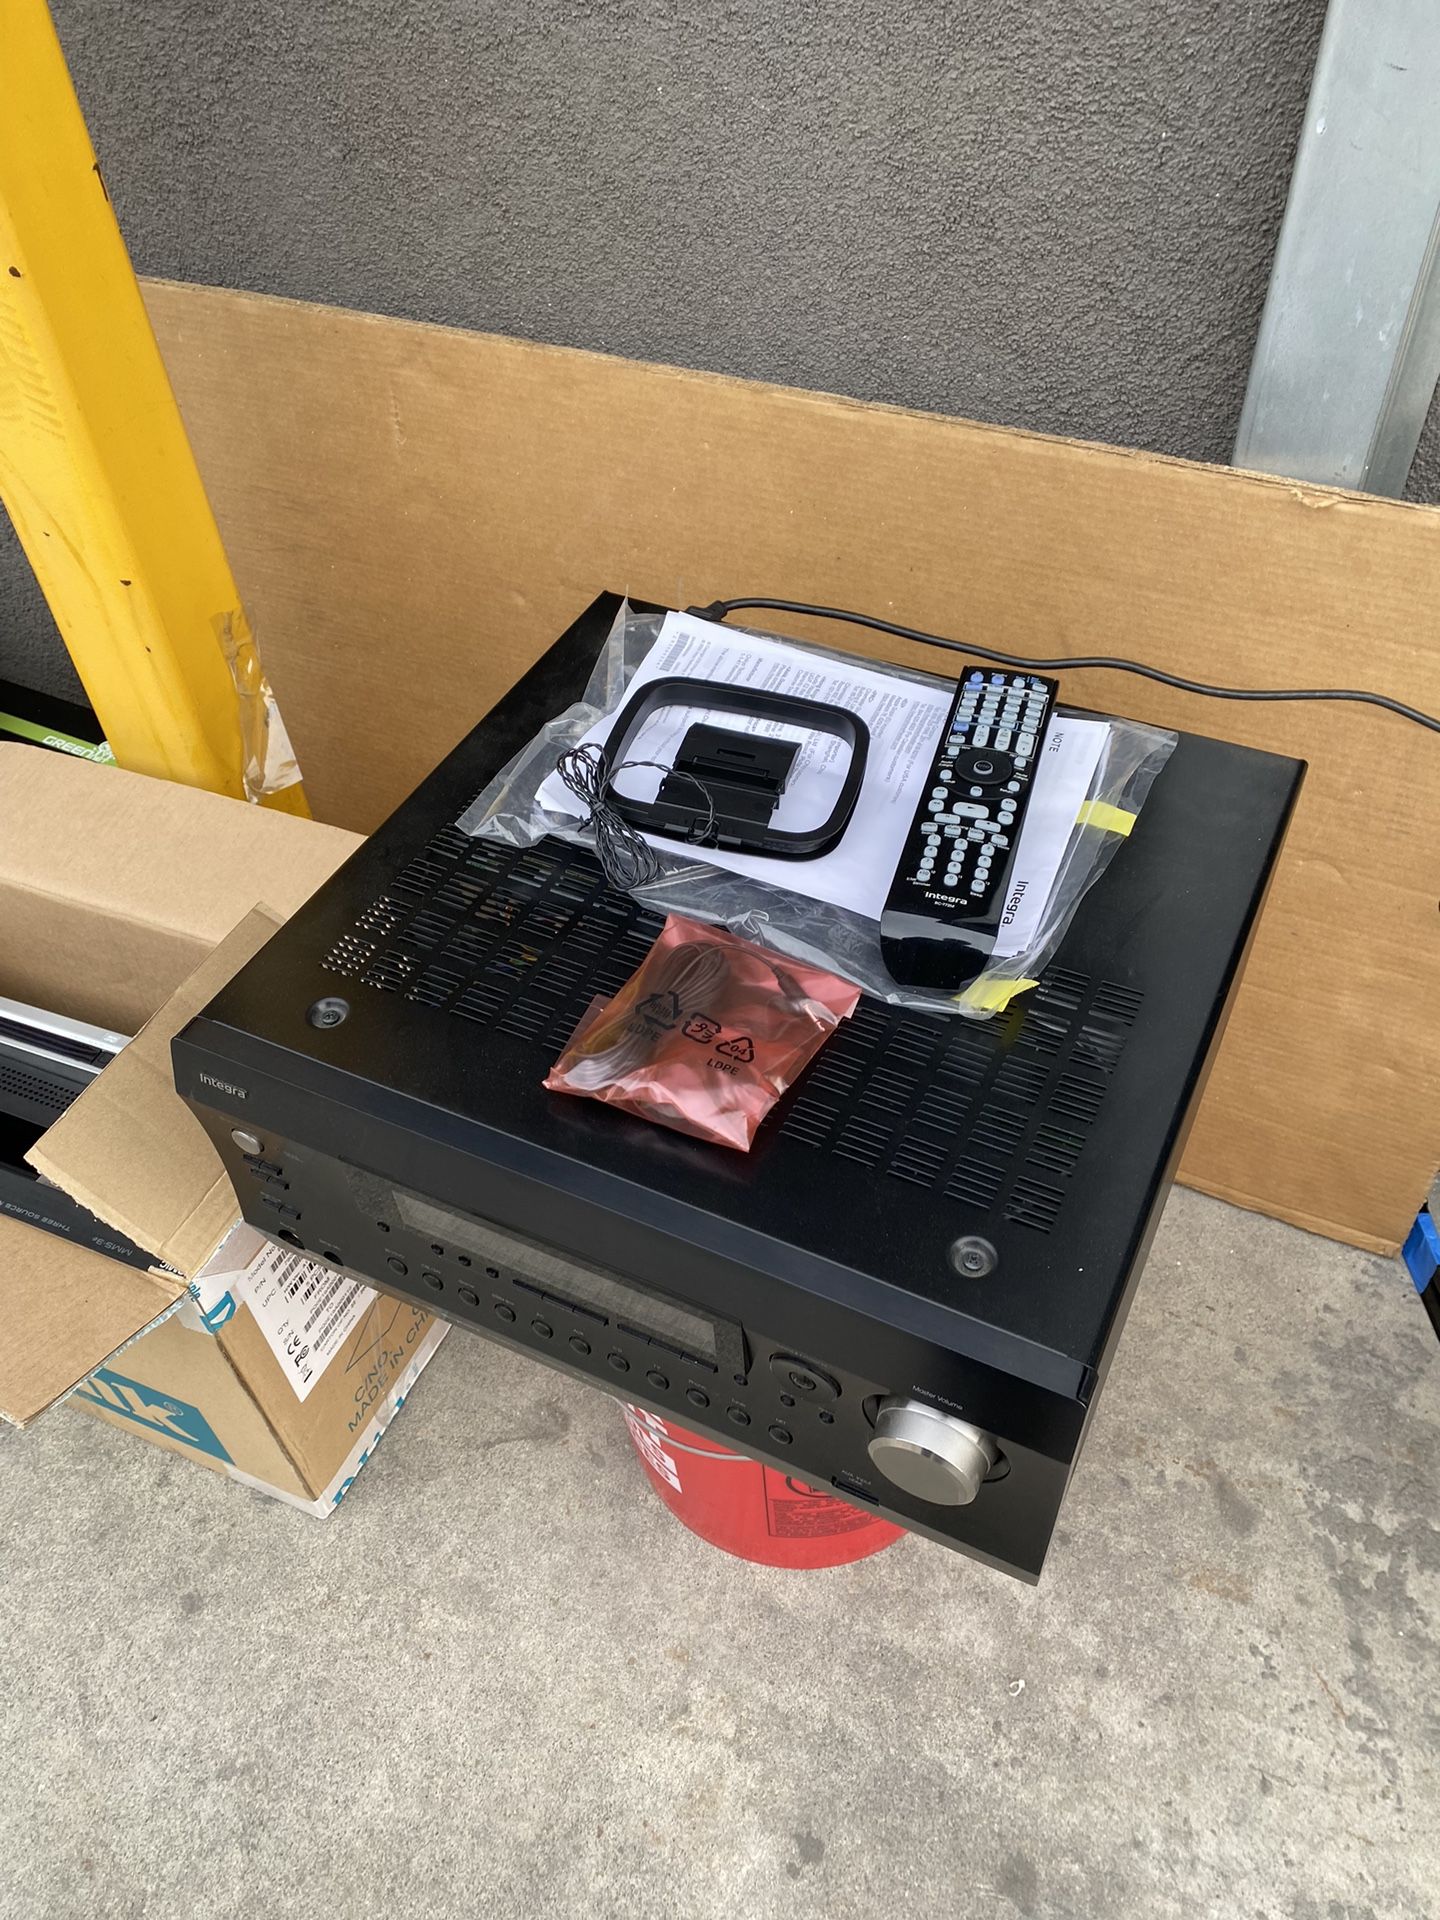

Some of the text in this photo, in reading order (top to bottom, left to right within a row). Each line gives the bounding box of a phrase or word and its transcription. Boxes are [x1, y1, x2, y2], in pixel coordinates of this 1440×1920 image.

[1048, 732, 1064, 752] NOTE
[924, 891, 968, 906] Integra
[706, 1057, 741, 1077] LDPE
[199, 1073, 248, 1099] Integra
[4, 1201, 72, 1233] THREE SOURCE
[247, 1257, 267, 1282] Model
[254, 1277, 267, 1294] P/N
[313, 1276, 330, 1299] FROM
[262, 1288, 277, 1308] UPC
[325, 1302, 335, 1313] TO
[354, 1350, 393, 1403] C/NO.
[348, 1375, 389, 1432] MADE
[390, 1347, 404, 1369] IN
[912, 1385, 963, 1410] Master Volume
